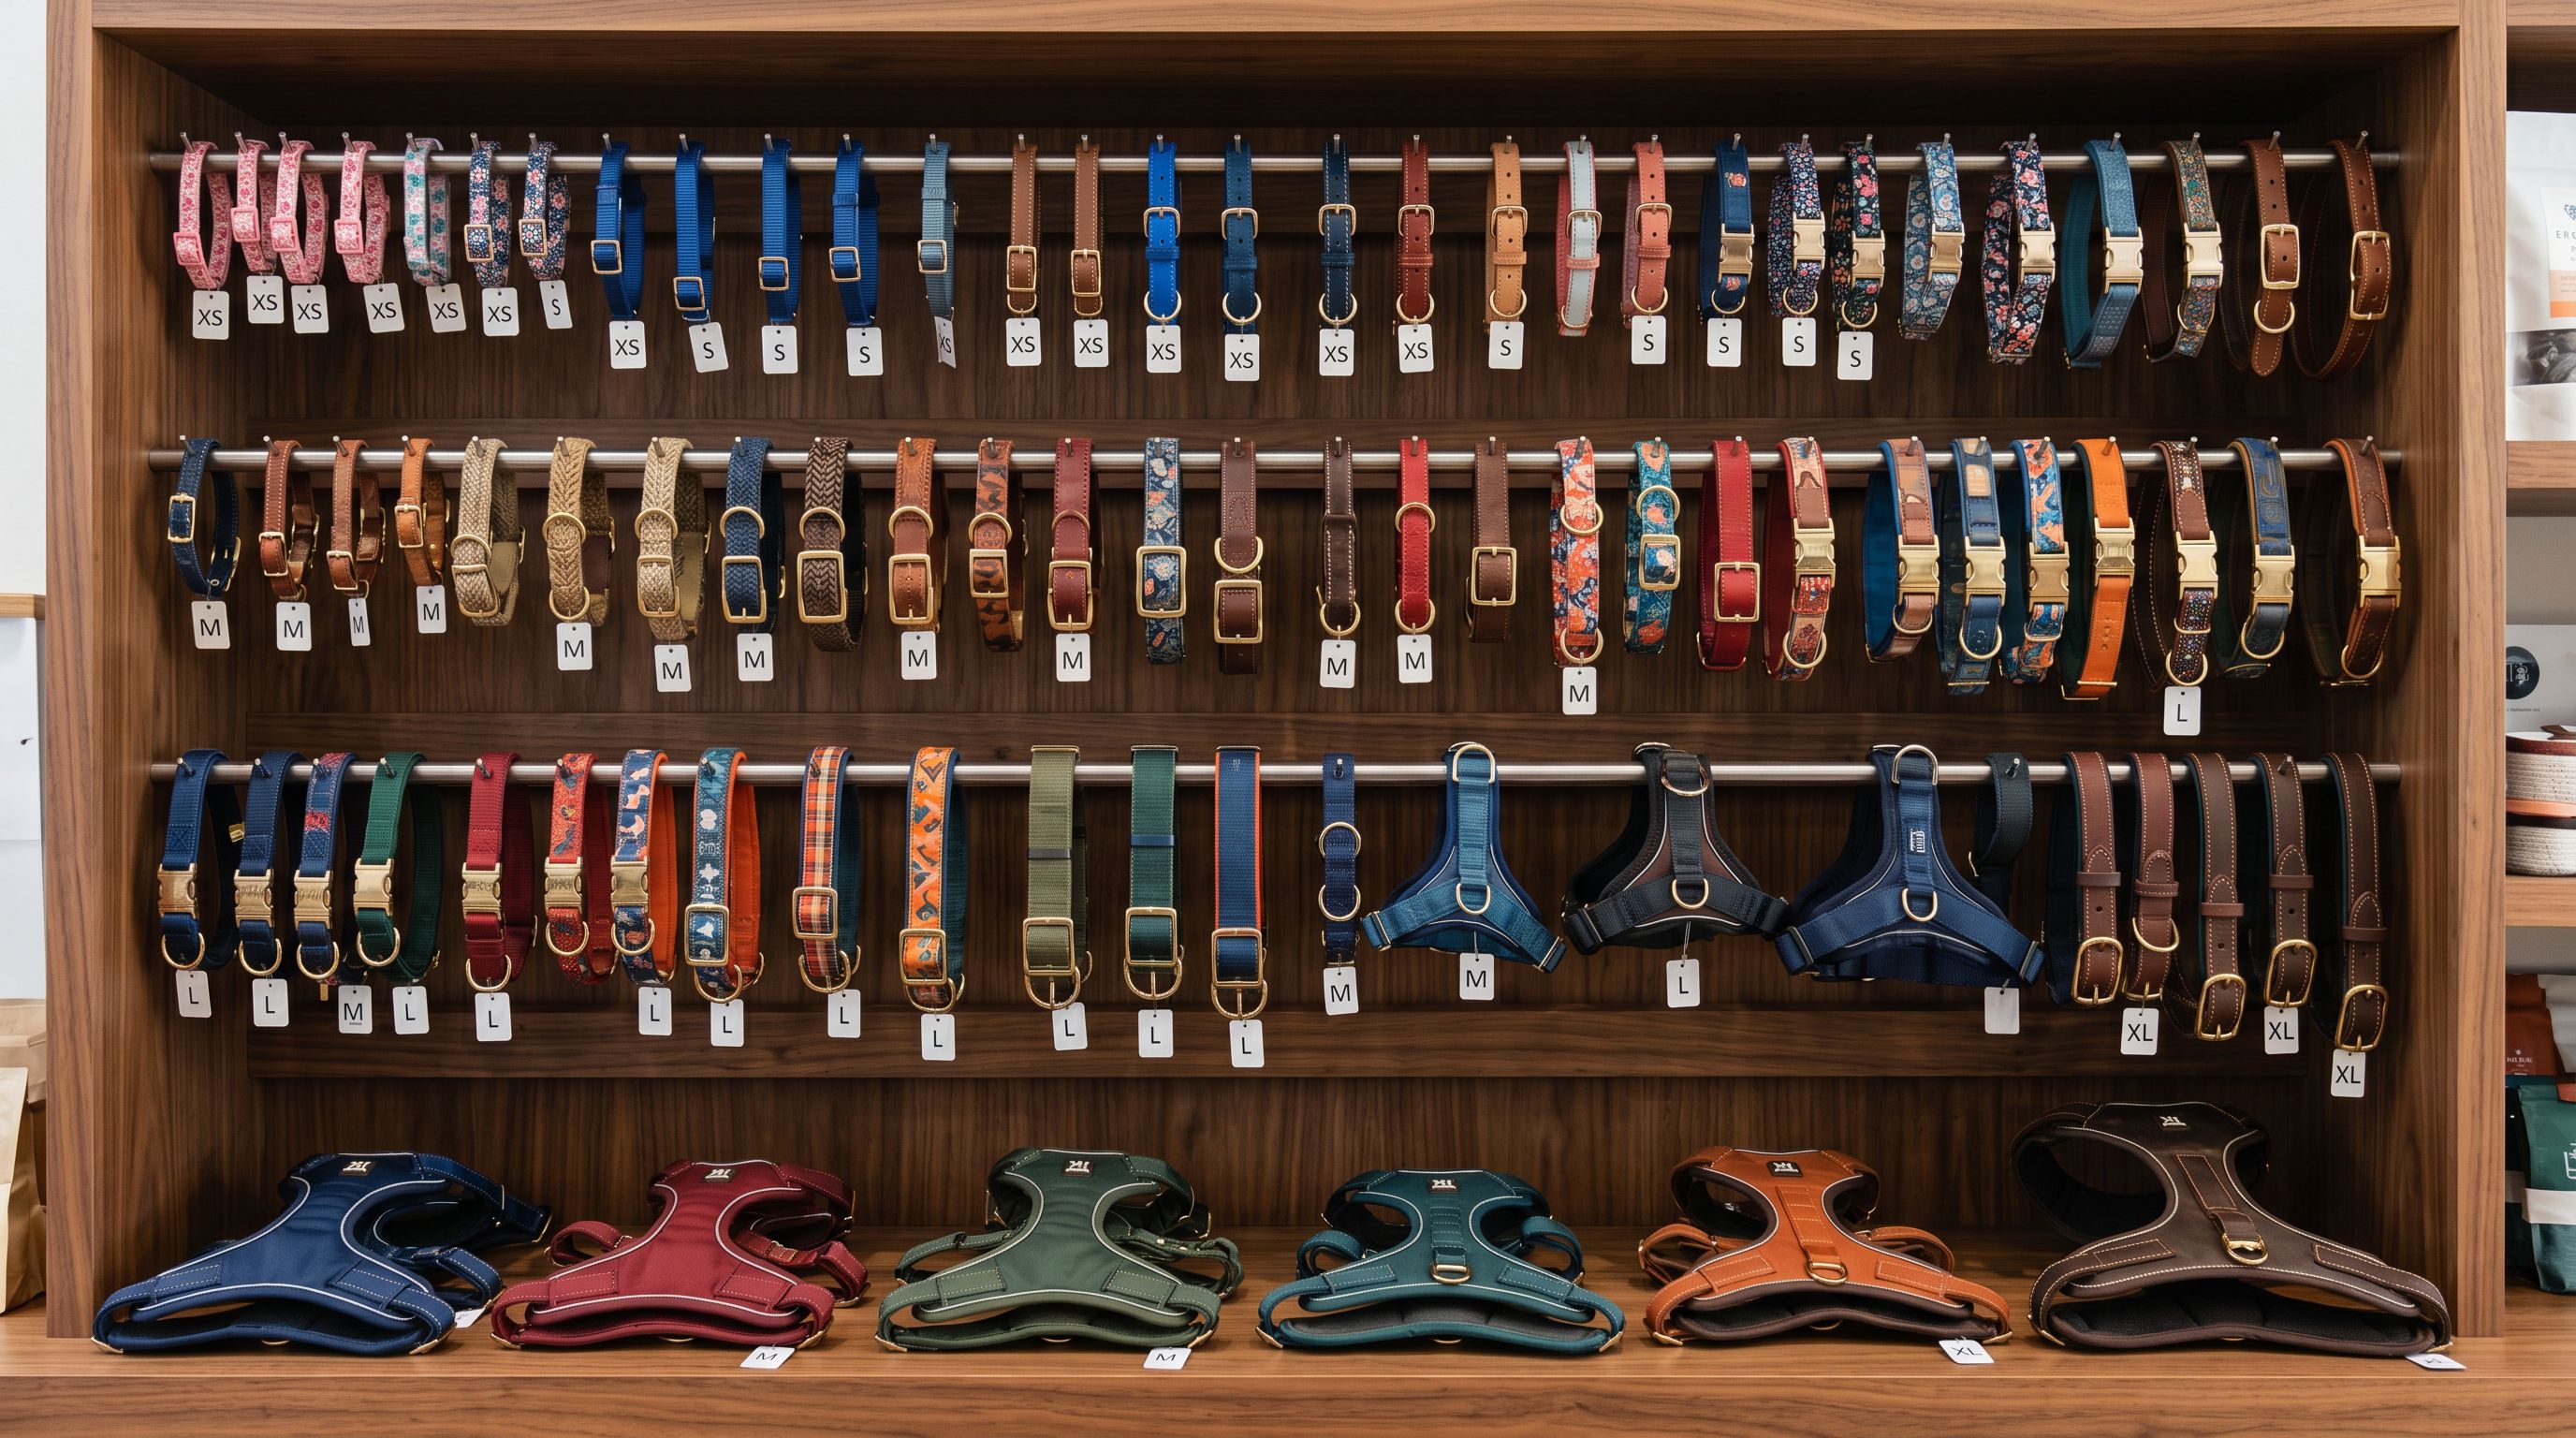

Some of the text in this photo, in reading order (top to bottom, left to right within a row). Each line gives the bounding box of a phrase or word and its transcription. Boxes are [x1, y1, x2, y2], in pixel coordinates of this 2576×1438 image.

[252, 294, 278, 311] XS
[297, 302, 322, 320] XS
[371, 301, 397, 320] XS
[433, 301, 459, 320] XS
[551, 298, 561, 316] S
[198, 308, 223, 327] XS
[488, 305, 512, 323] XS
[615, 339, 640, 356] XS
[703, 342, 714, 360] S
[938, 332, 952, 354] XS
[1011, 335, 1036, 354] XS
[1079, 337, 1104, 354] XS
[1151, 343, 1176, 360] XS
[1404, 342, 1428, 360] XS
[1500, 339, 1512, 357] S
[1643, 333, 1655, 352] S
[1719, 336, 1730, 354] S
[1793, 335, 1805, 353] S
[774, 344, 785, 361] S
[859, 345, 871, 364] S
[1229, 352, 1254, 369] XS
[1324, 345, 1349, 363] XS
[1850, 349, 1862, 368] S
[423, 602, 440, 621] M
[199, 618, 221, 637] M
[284, 620, 303, 638] M
[353, 615, 364, 634] M
[564, 639, 584, 658] M
[744, 650, 765, 668] M
[908, 649, 929, 668] M
[1062, 651, 1083, 669] M
[1326, 657, 1347, 676] M
[1405, 652, 1426, 670] M
[662, 662, 682, 680] M
[1569, 684, 1589, 703] M
[2176, 703, 2188, 723] L
[1466, 969, 1486, 989] M
[1678, 976, 1690, 994] L
[188, 986, 199, 1005] L
[1330, 984, 1351, 1003] M
[265, 995, 276, 1014] L
[344, 1003, 363, 1021] M
[404, 1003, 416, 1021] L
[650, 1004, 661, 1022] L
[488, 1010, 499, 1028] L
[840, 1005, 850, 1025] L
[723, 1015, 733, 1034] L
[1064, 1019, 1076, 1037] L
[2127, 1023, 2154, 1042] XL
[2268, 1021, 2295, 1040] XL
[933, 1030, 944, 1048] L
[1150, 1025, 1162, 1045] L
[1241, 1036, 1252, 1055] L
[2335, 1065, 2361, 1084] XL
[756, 1352, 778, 1361] M
[1156, 1353, 1177, 1361] M
[1951, 1346, 1983, 1356] XL
